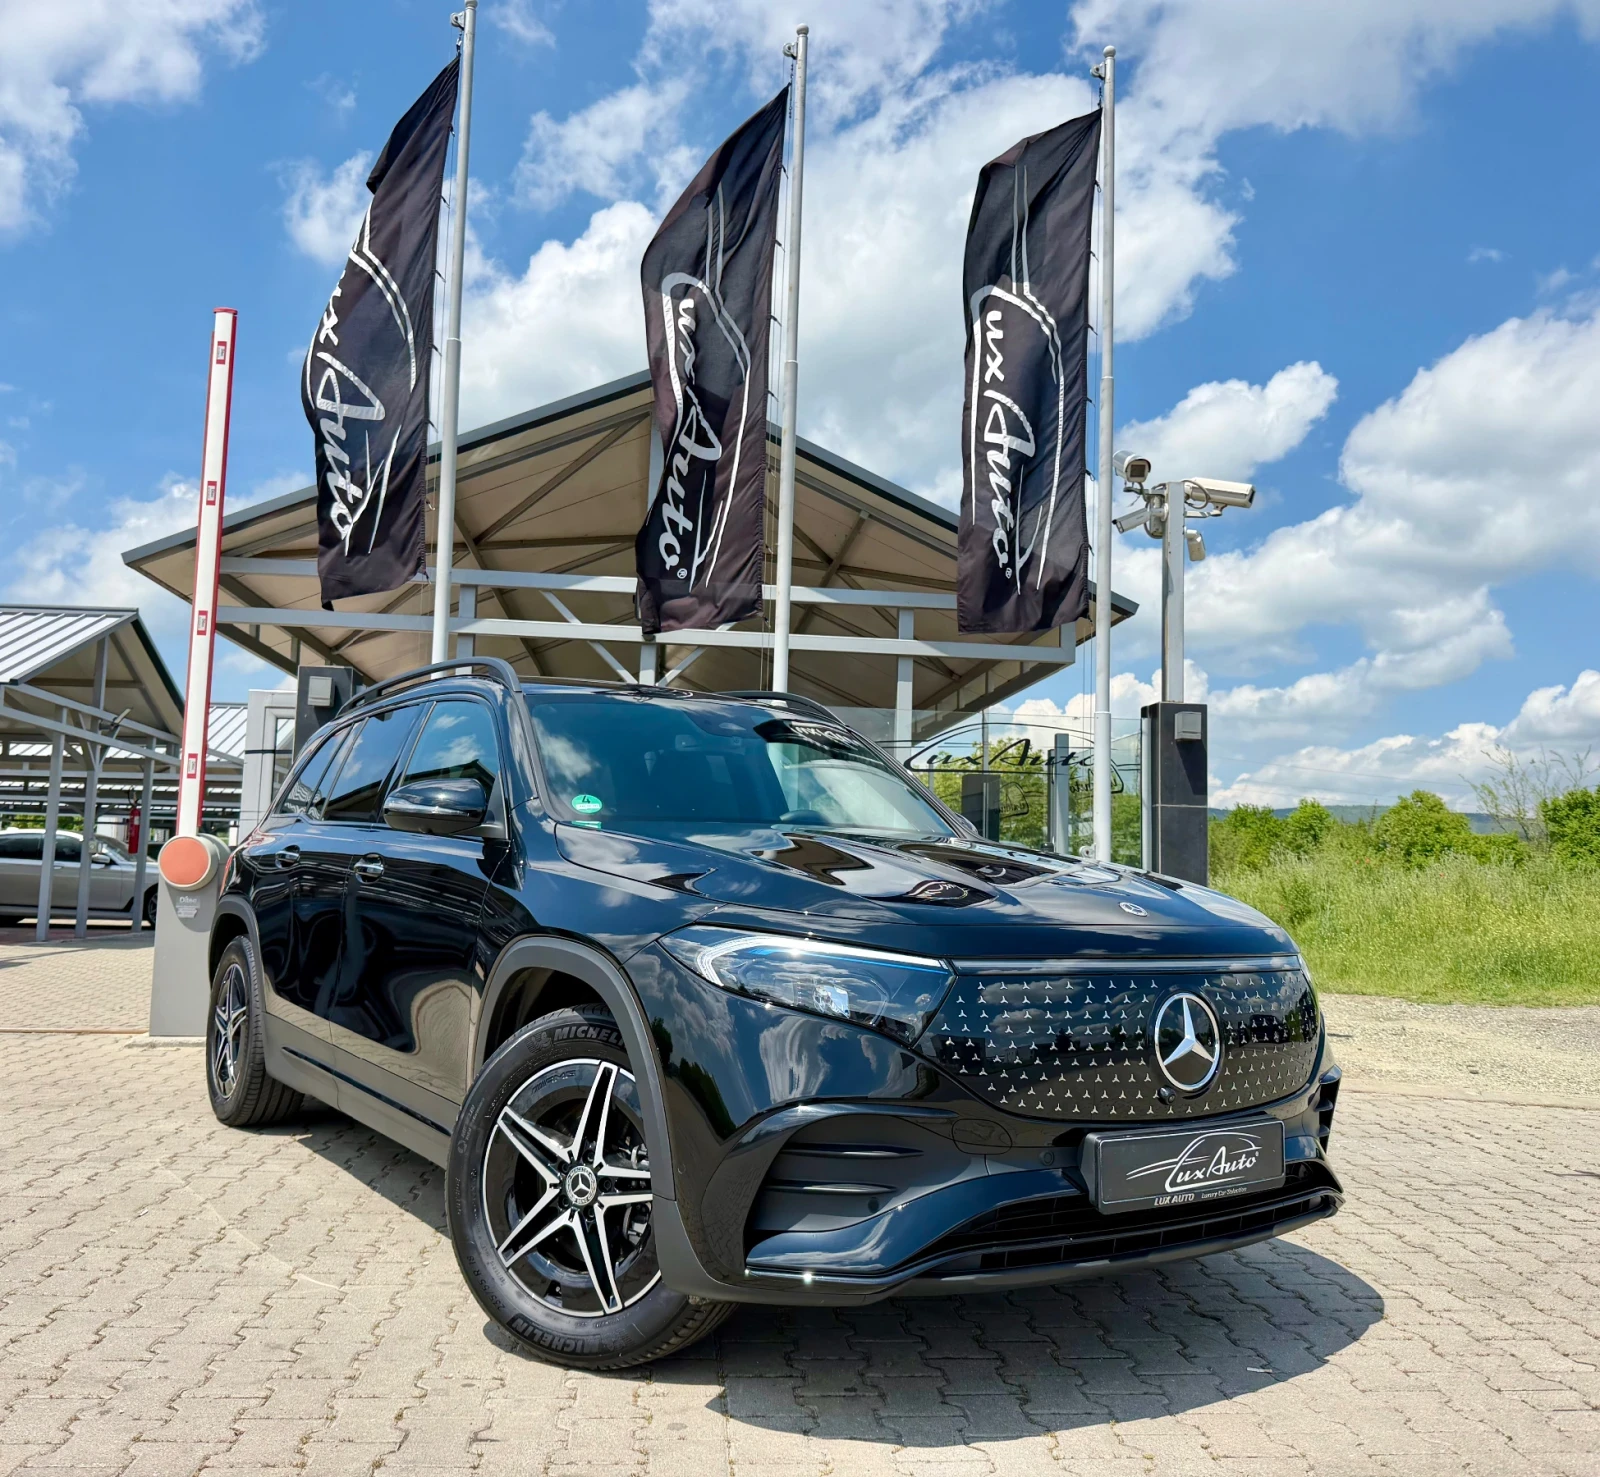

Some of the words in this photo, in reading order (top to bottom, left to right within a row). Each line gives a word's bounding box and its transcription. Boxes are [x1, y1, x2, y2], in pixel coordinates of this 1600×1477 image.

[553, 1025, 625, 1047] MICHELI
[1153, 1195, 1172, 1206] LUX
[1171, 1193, 1195, 1204] AUTO
[1201, 1191, 1218, 1199] Luxury
[511, 1318, 600, 1354] MICHELIN
